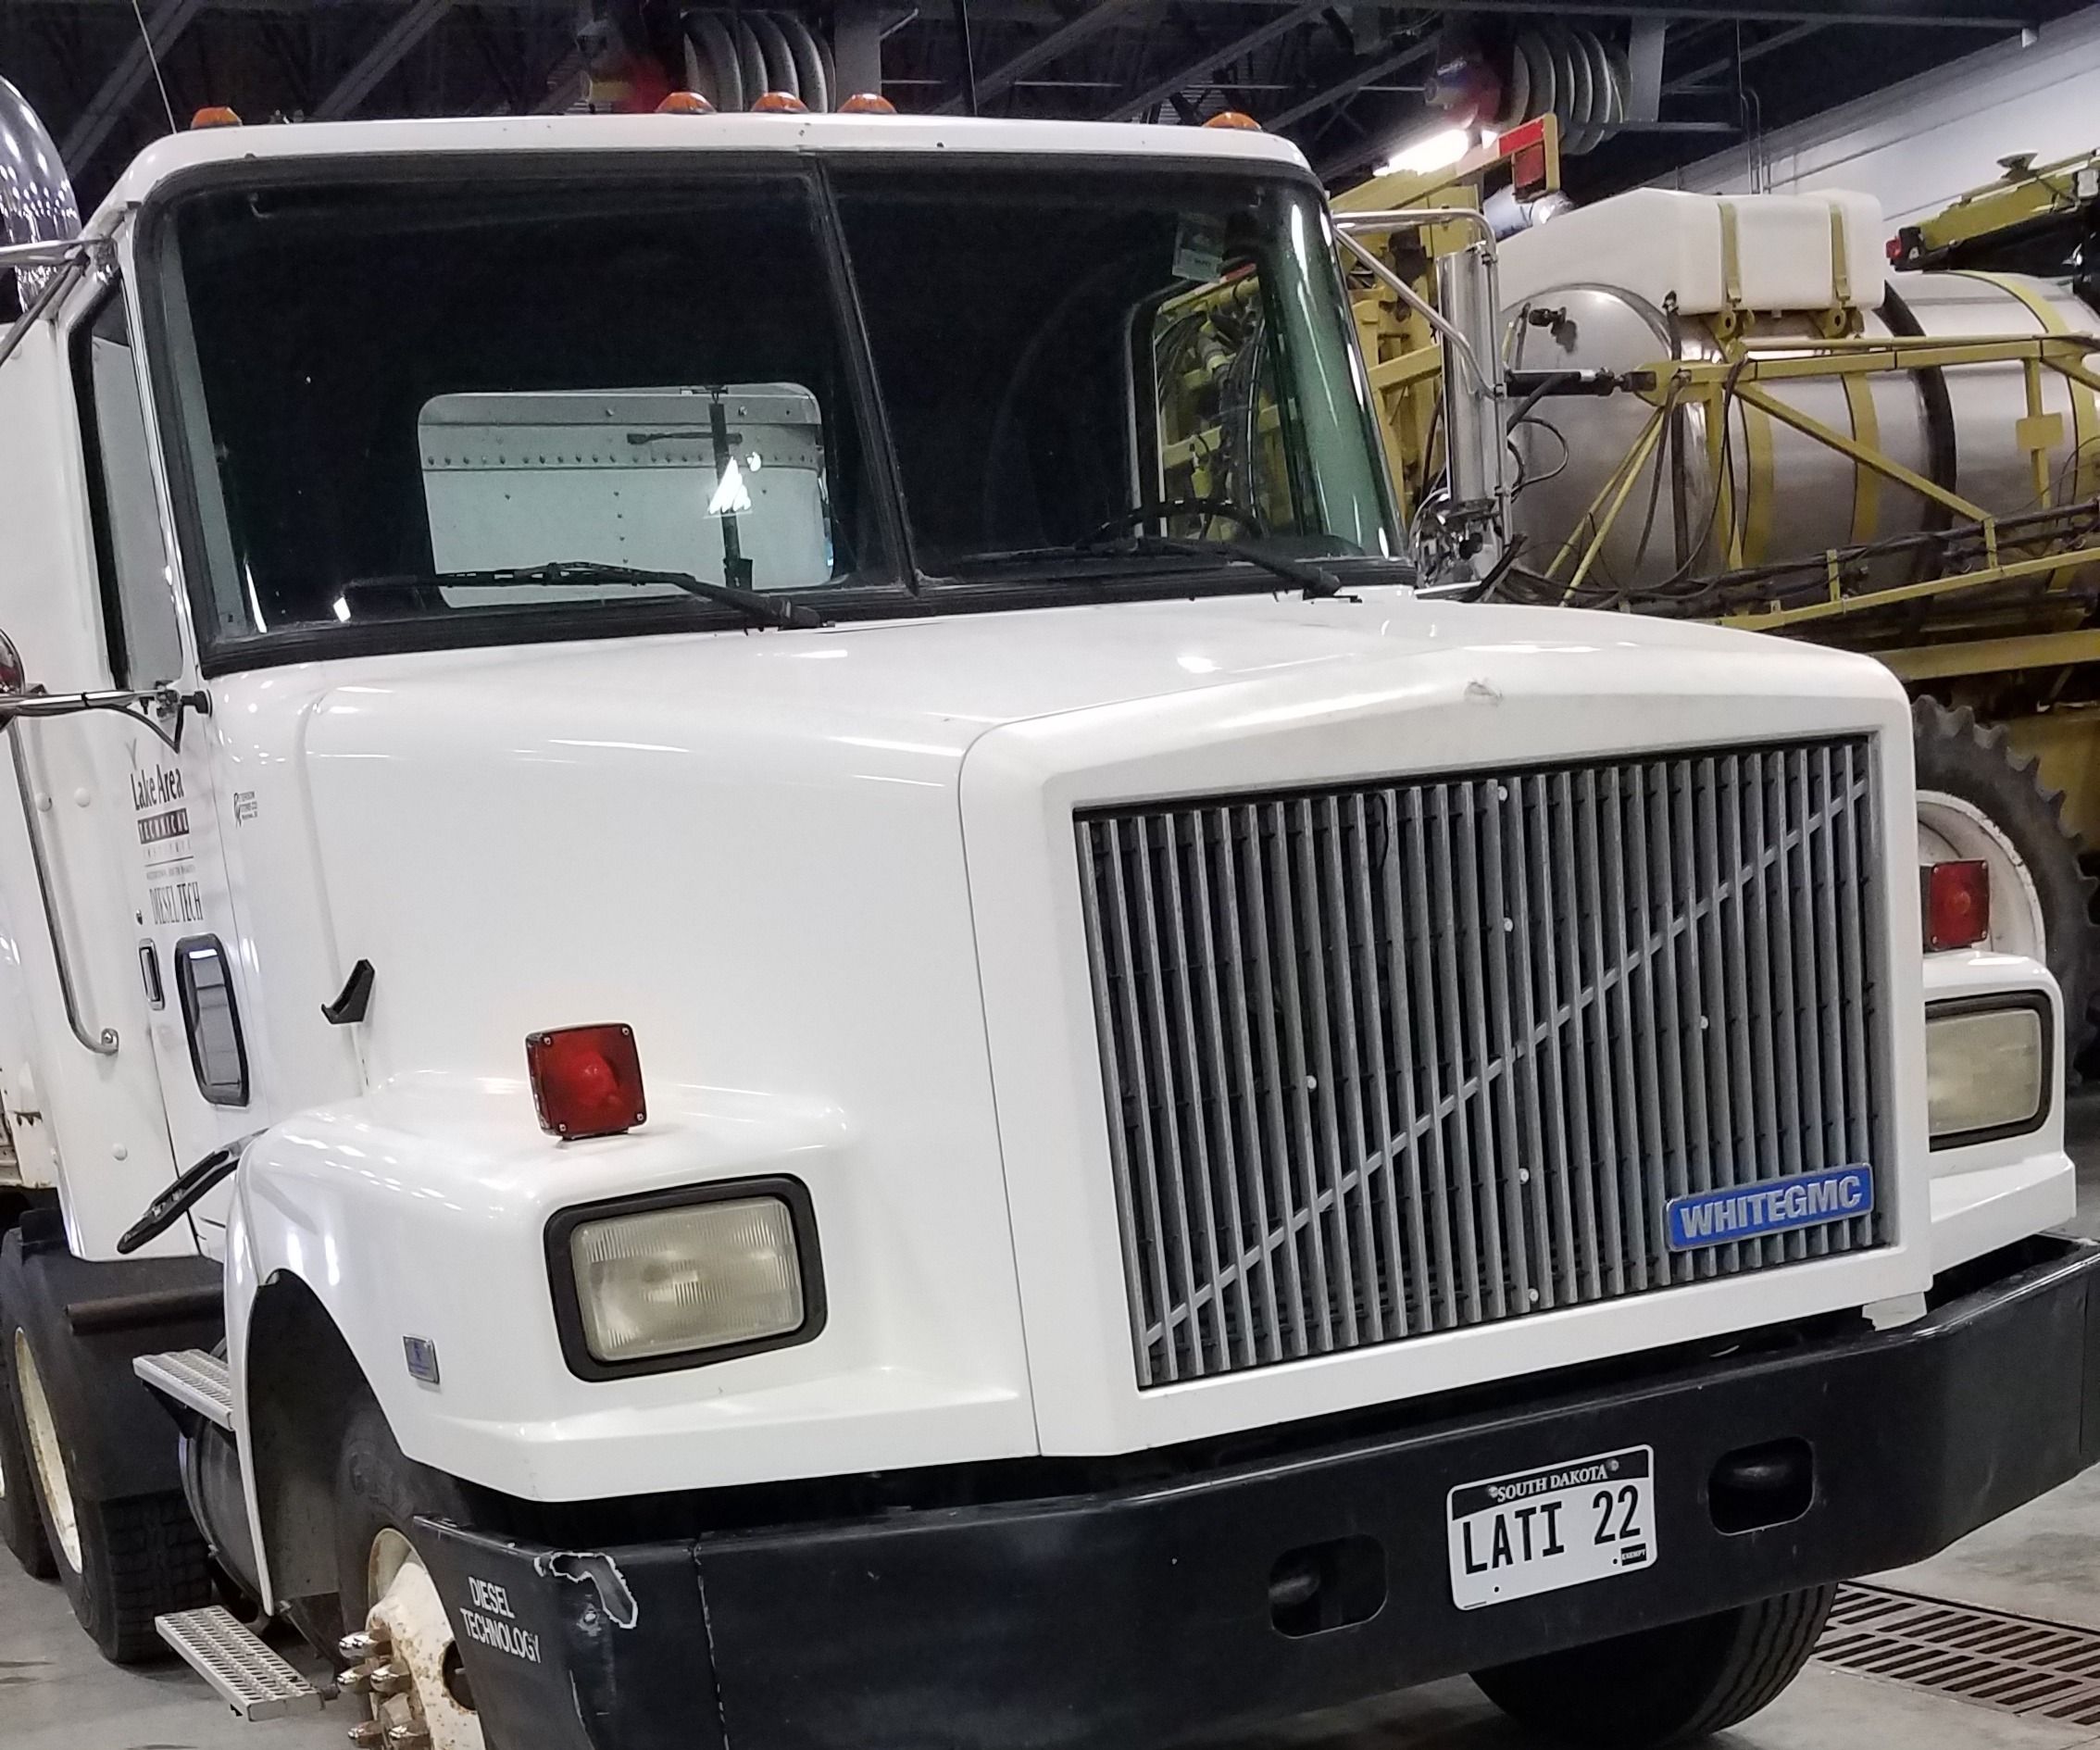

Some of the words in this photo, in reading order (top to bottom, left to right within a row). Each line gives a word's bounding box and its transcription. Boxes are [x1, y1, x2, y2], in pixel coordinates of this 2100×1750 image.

[131, 769, 157, 811] Lake
[156, 764, 184, 804] Area
[149, 884, 180, 925] DIESEL
[177, 881, 204, 922] TECH
[1680, 1176, 1863, 1238] WHITEGMC
[1497, 1477, 1546, 1503] SOUTH
[1550, 1464, 1608, 1488] DAKOTA
[1463, 1501, 1565, 1575] LATI
[1593, 1485, 1641, 1545] 22
[468, 1576, 516, 1619] DIESEL
[459, 1607, 541, 1664] TECHNOLOGY
